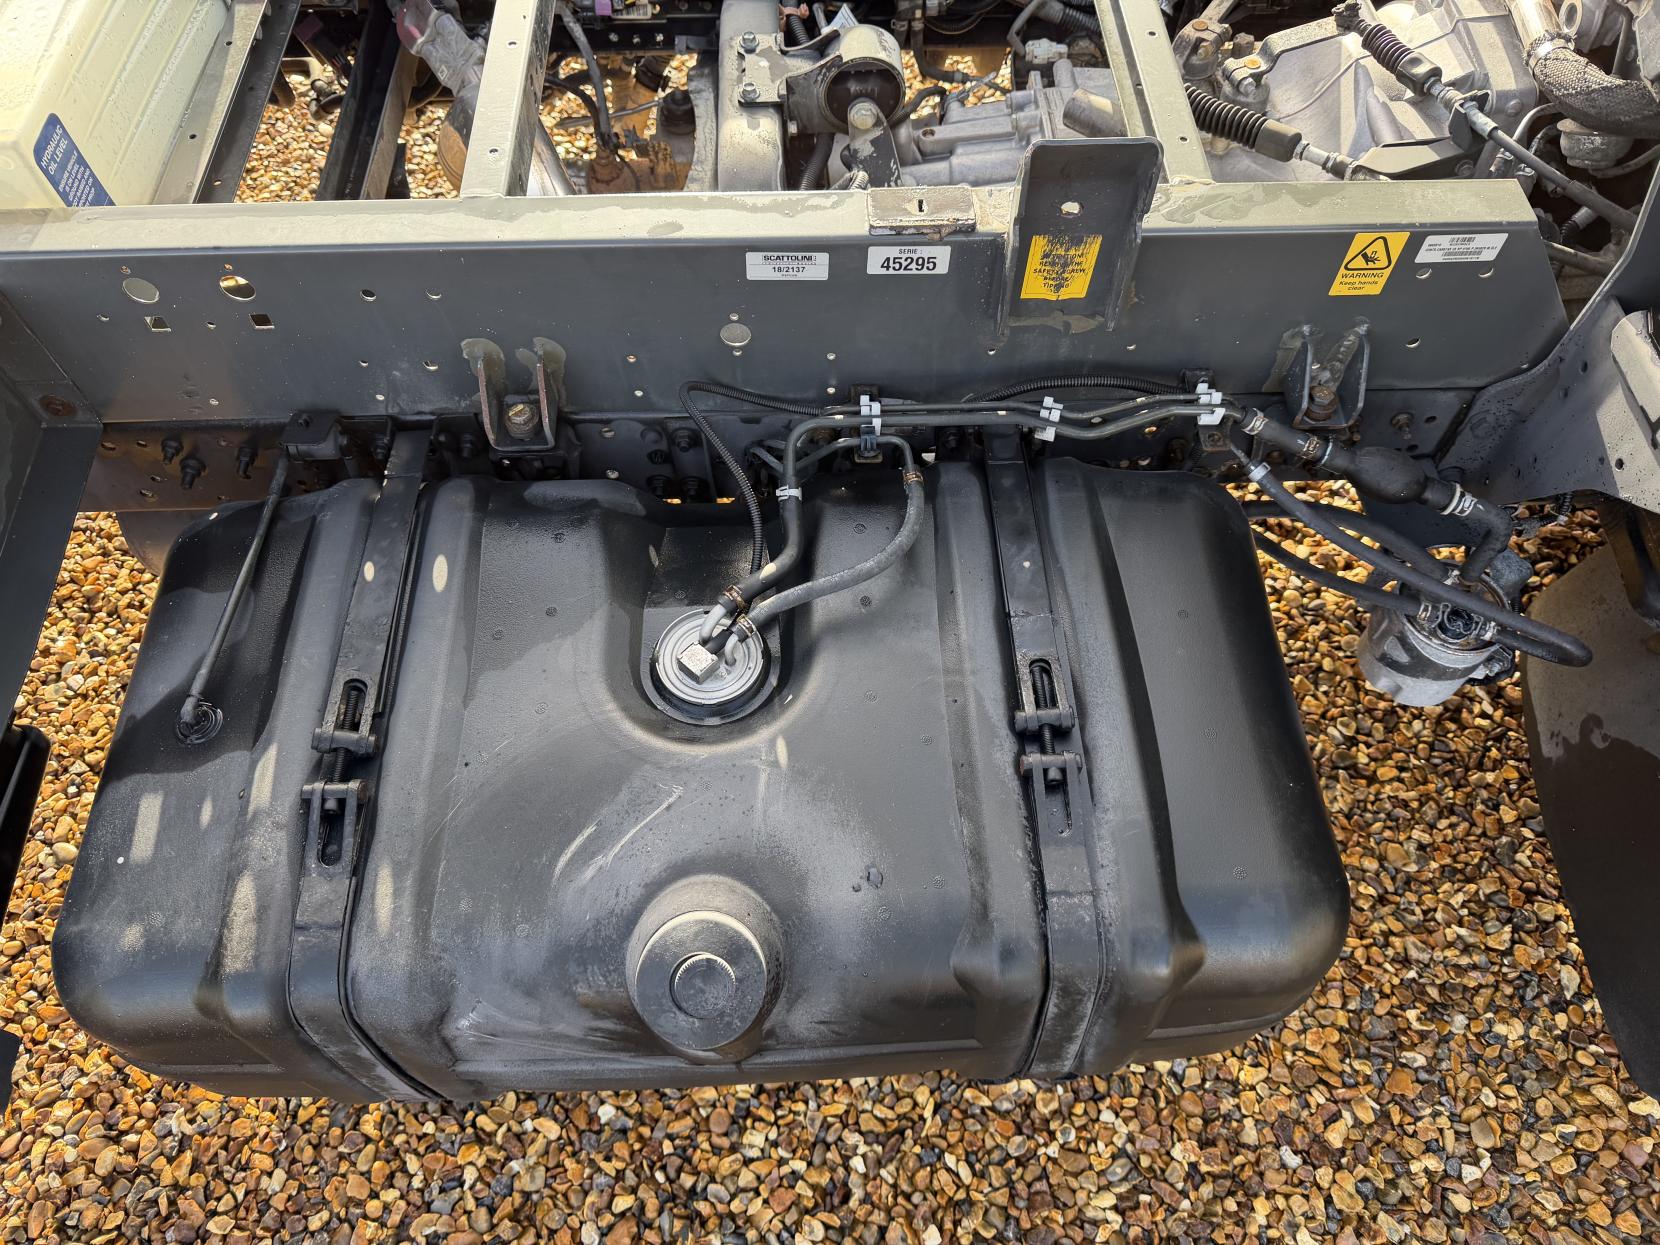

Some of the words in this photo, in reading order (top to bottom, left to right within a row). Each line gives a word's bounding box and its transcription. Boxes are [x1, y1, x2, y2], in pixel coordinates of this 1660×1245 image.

[40, 124, 62, 168] HYDRAULIC
[48, 162, 58, 175] OIL
[54, 138, 68, 162] LEVEL
[880, 256, 937, 271] 45295
